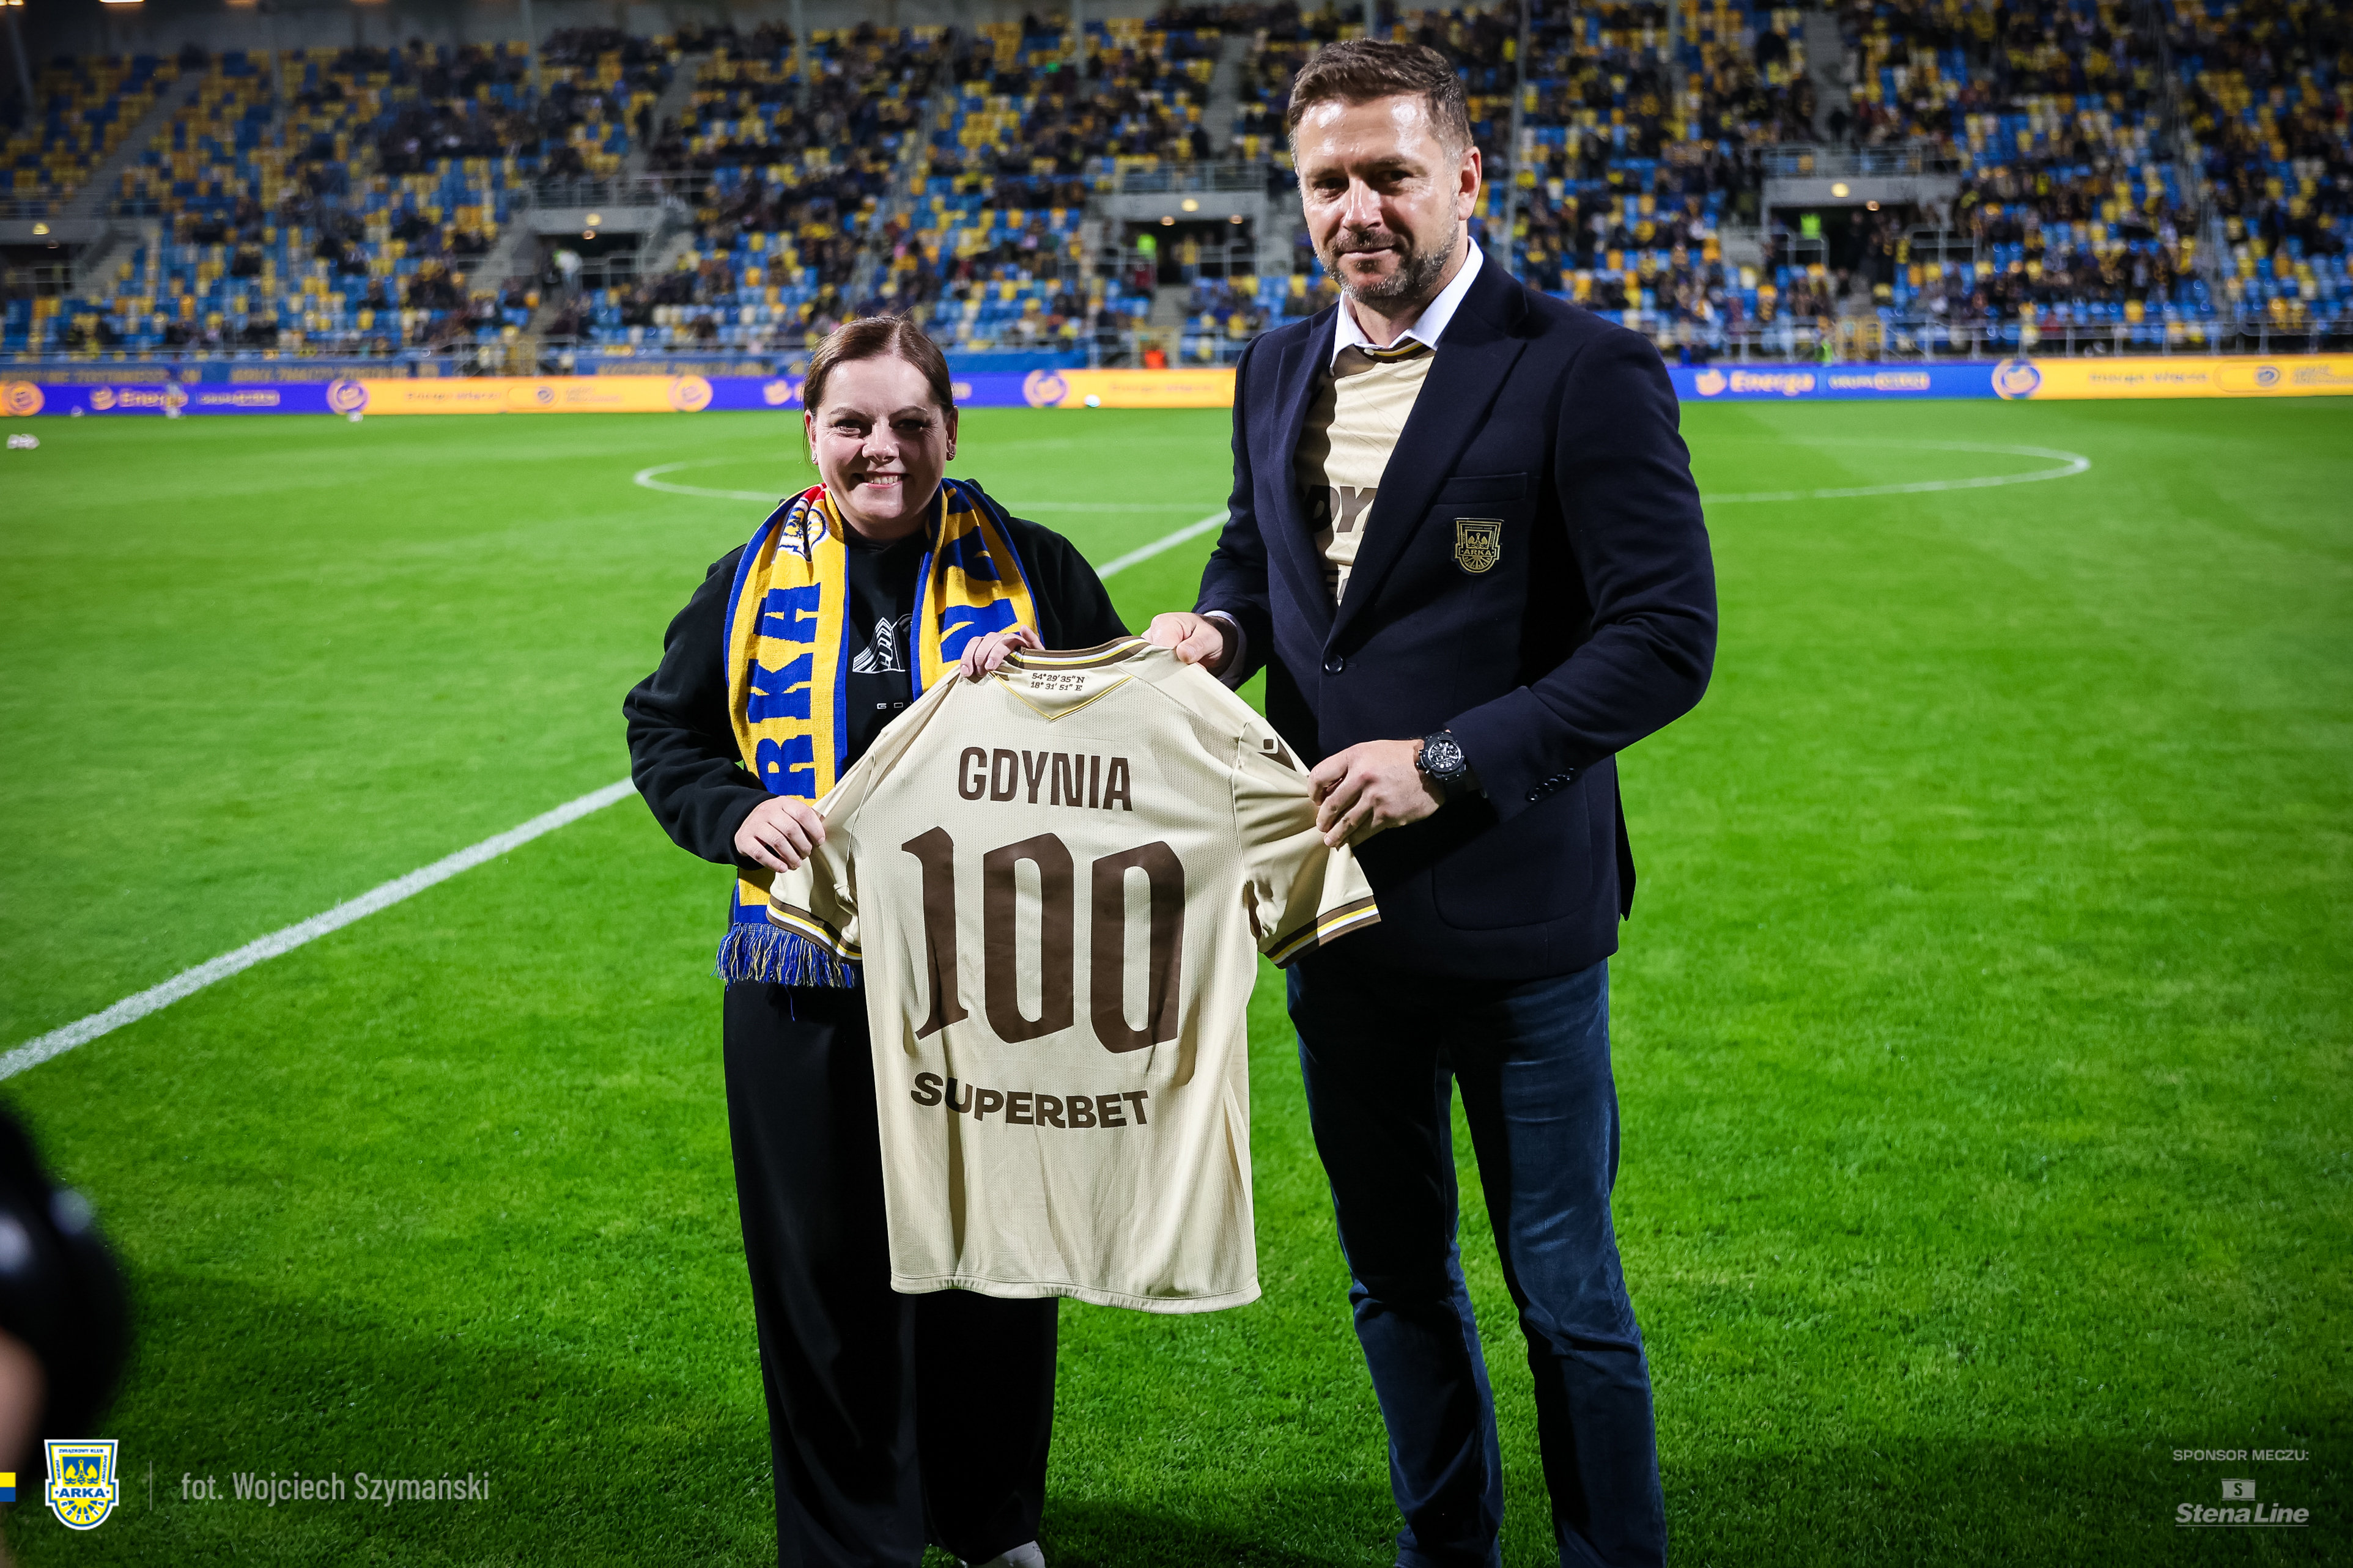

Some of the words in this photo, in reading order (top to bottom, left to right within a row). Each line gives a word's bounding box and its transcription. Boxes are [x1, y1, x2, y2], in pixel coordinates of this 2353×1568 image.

[747, 582, 821, 800] RKA
[958, 746, 1133, 812] GDYNIA
[901, 825, 1186, 1054] 100
[910, 1072, 1149, 1128] SUPERBET
